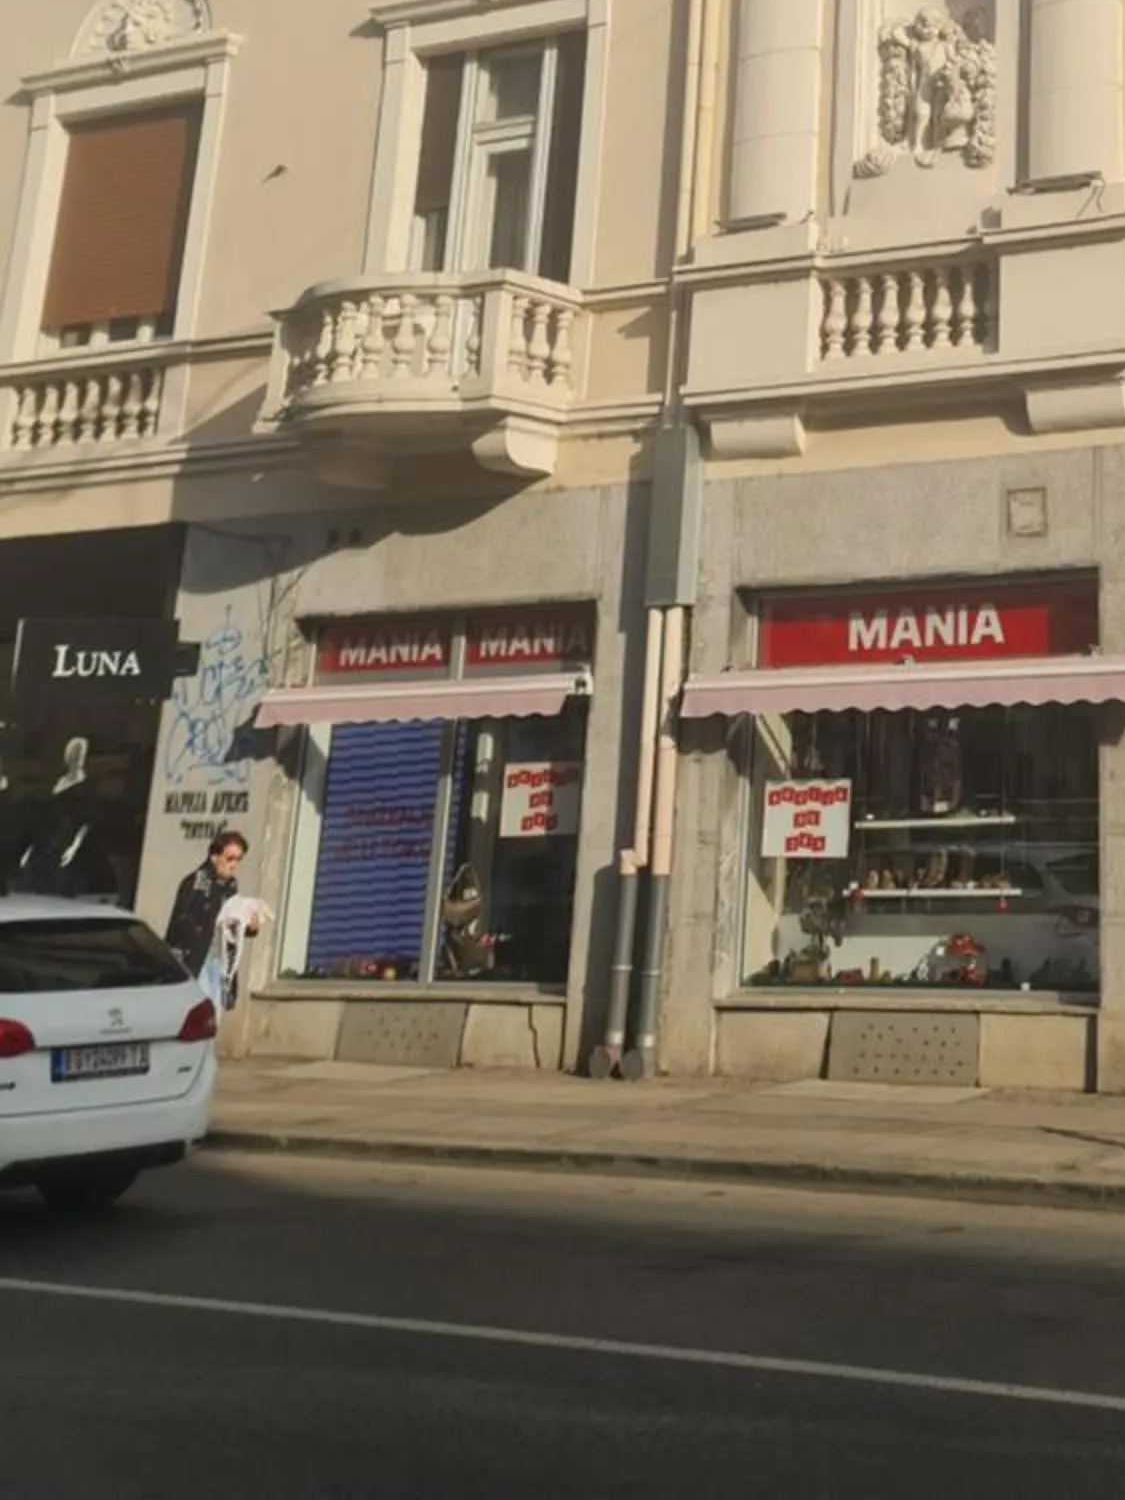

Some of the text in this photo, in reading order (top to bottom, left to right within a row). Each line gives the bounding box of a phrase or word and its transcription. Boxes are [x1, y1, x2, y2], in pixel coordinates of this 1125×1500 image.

[480, 622, 590, 658] MANIA
[848, 603, 1005, 650] MANIA
[52, 644, 141, 677] LUNA
[339, 630, 443, 667] MANIA
